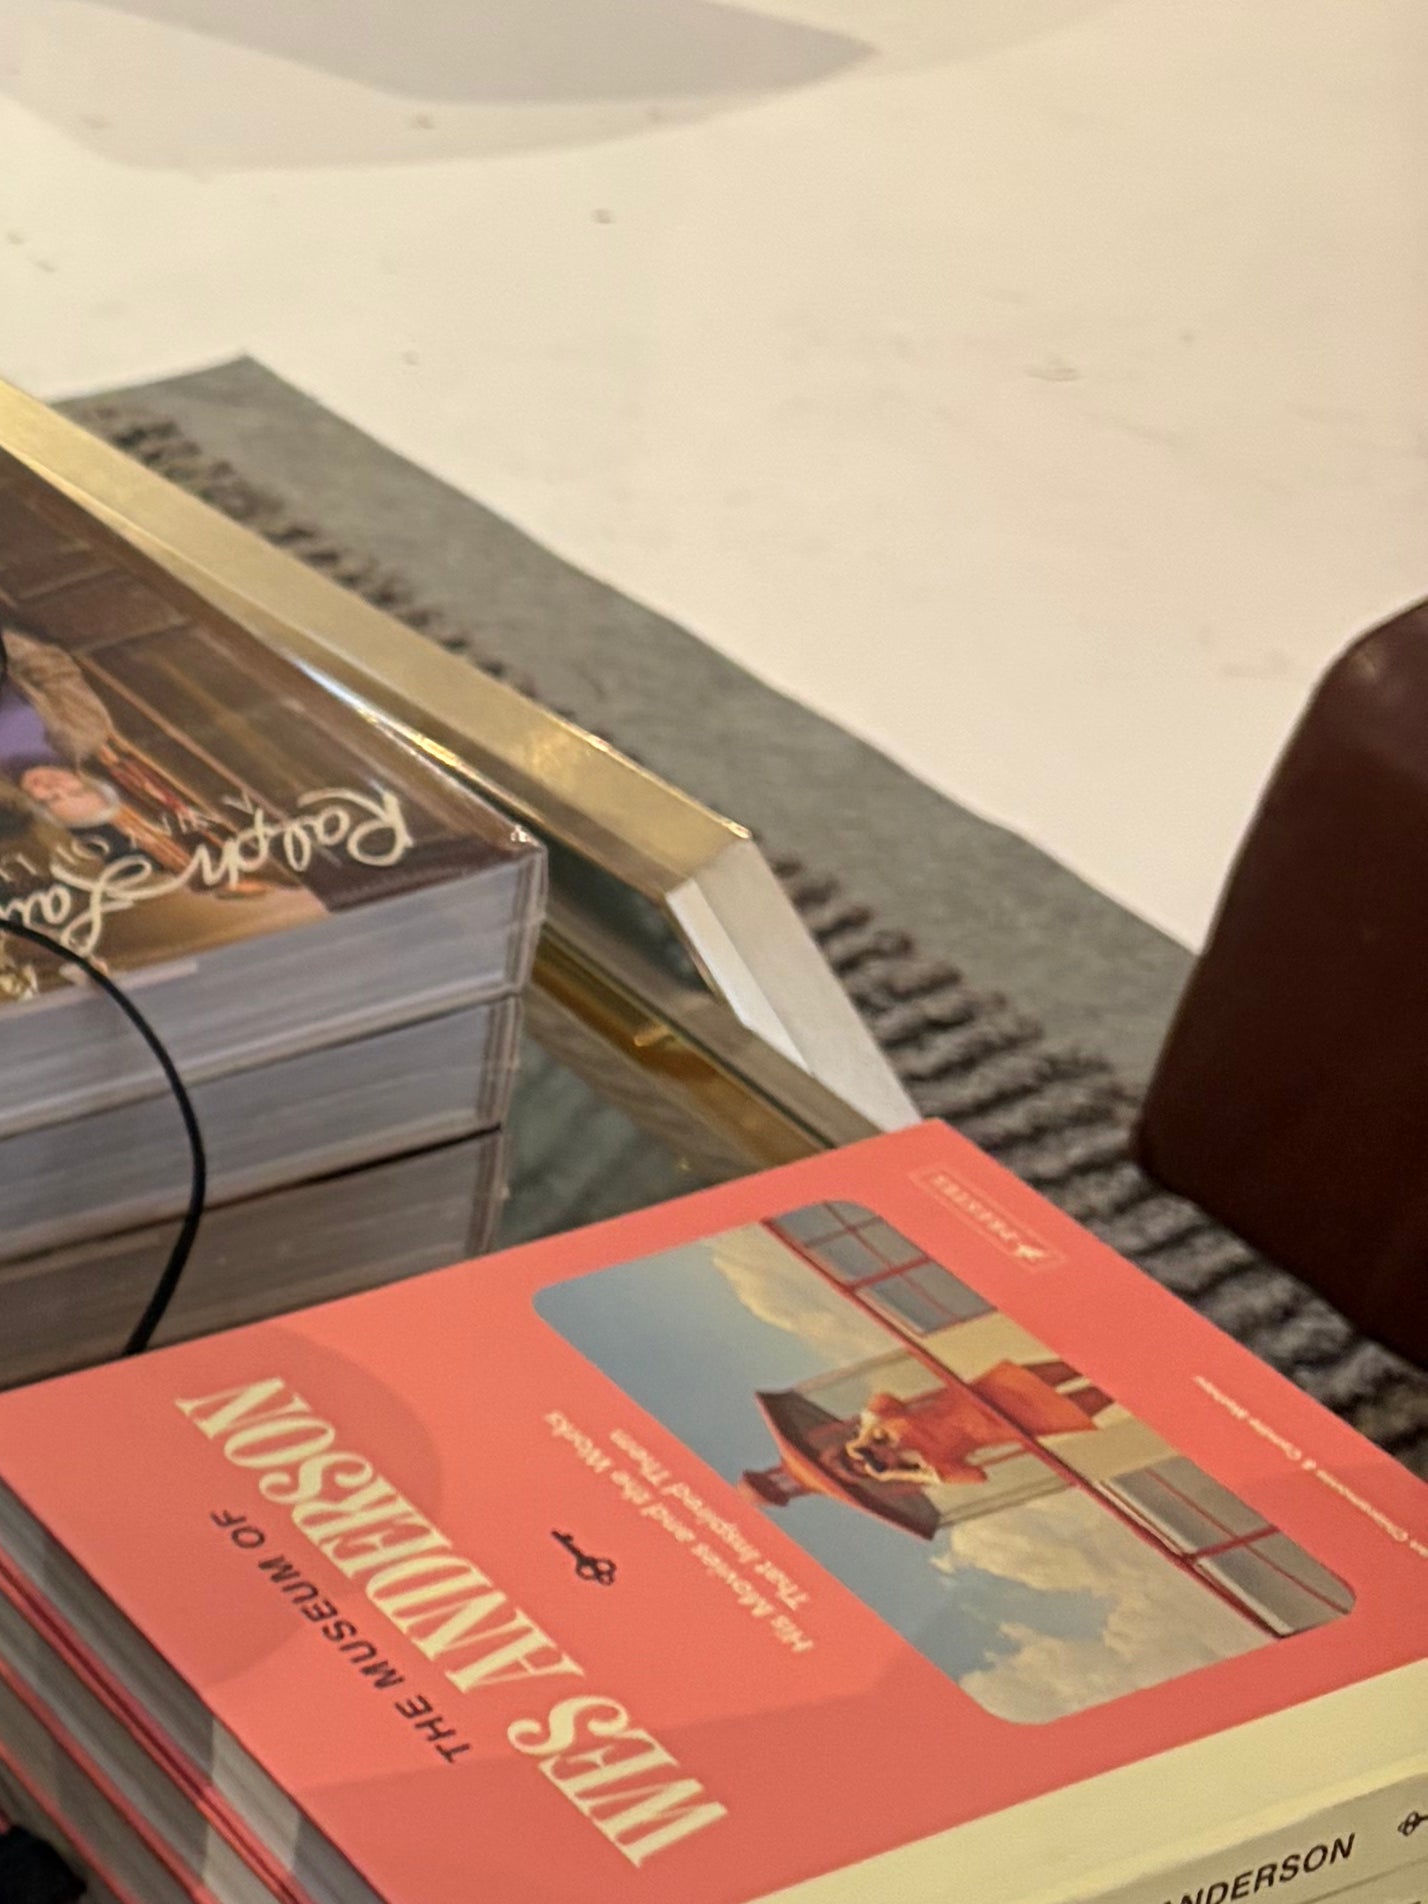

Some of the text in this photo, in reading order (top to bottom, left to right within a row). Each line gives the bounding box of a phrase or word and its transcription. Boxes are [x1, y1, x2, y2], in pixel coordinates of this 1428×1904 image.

[189, 786, 414, 888] Ralph
[544, 1410, 612, 1474] Works
[611, 1470, 651, 1505] the
[641, 1502, 696, 1542] and
[660, 1481, 762, 1564] Inspired
[691, 1543, 775, 1617] Movies
[754, 1560, 810, 1610] That
[174, 1377, 729, 1868] WES ANDERSON
[210, 1508, 473, 1764] THE MUSEUM OF
